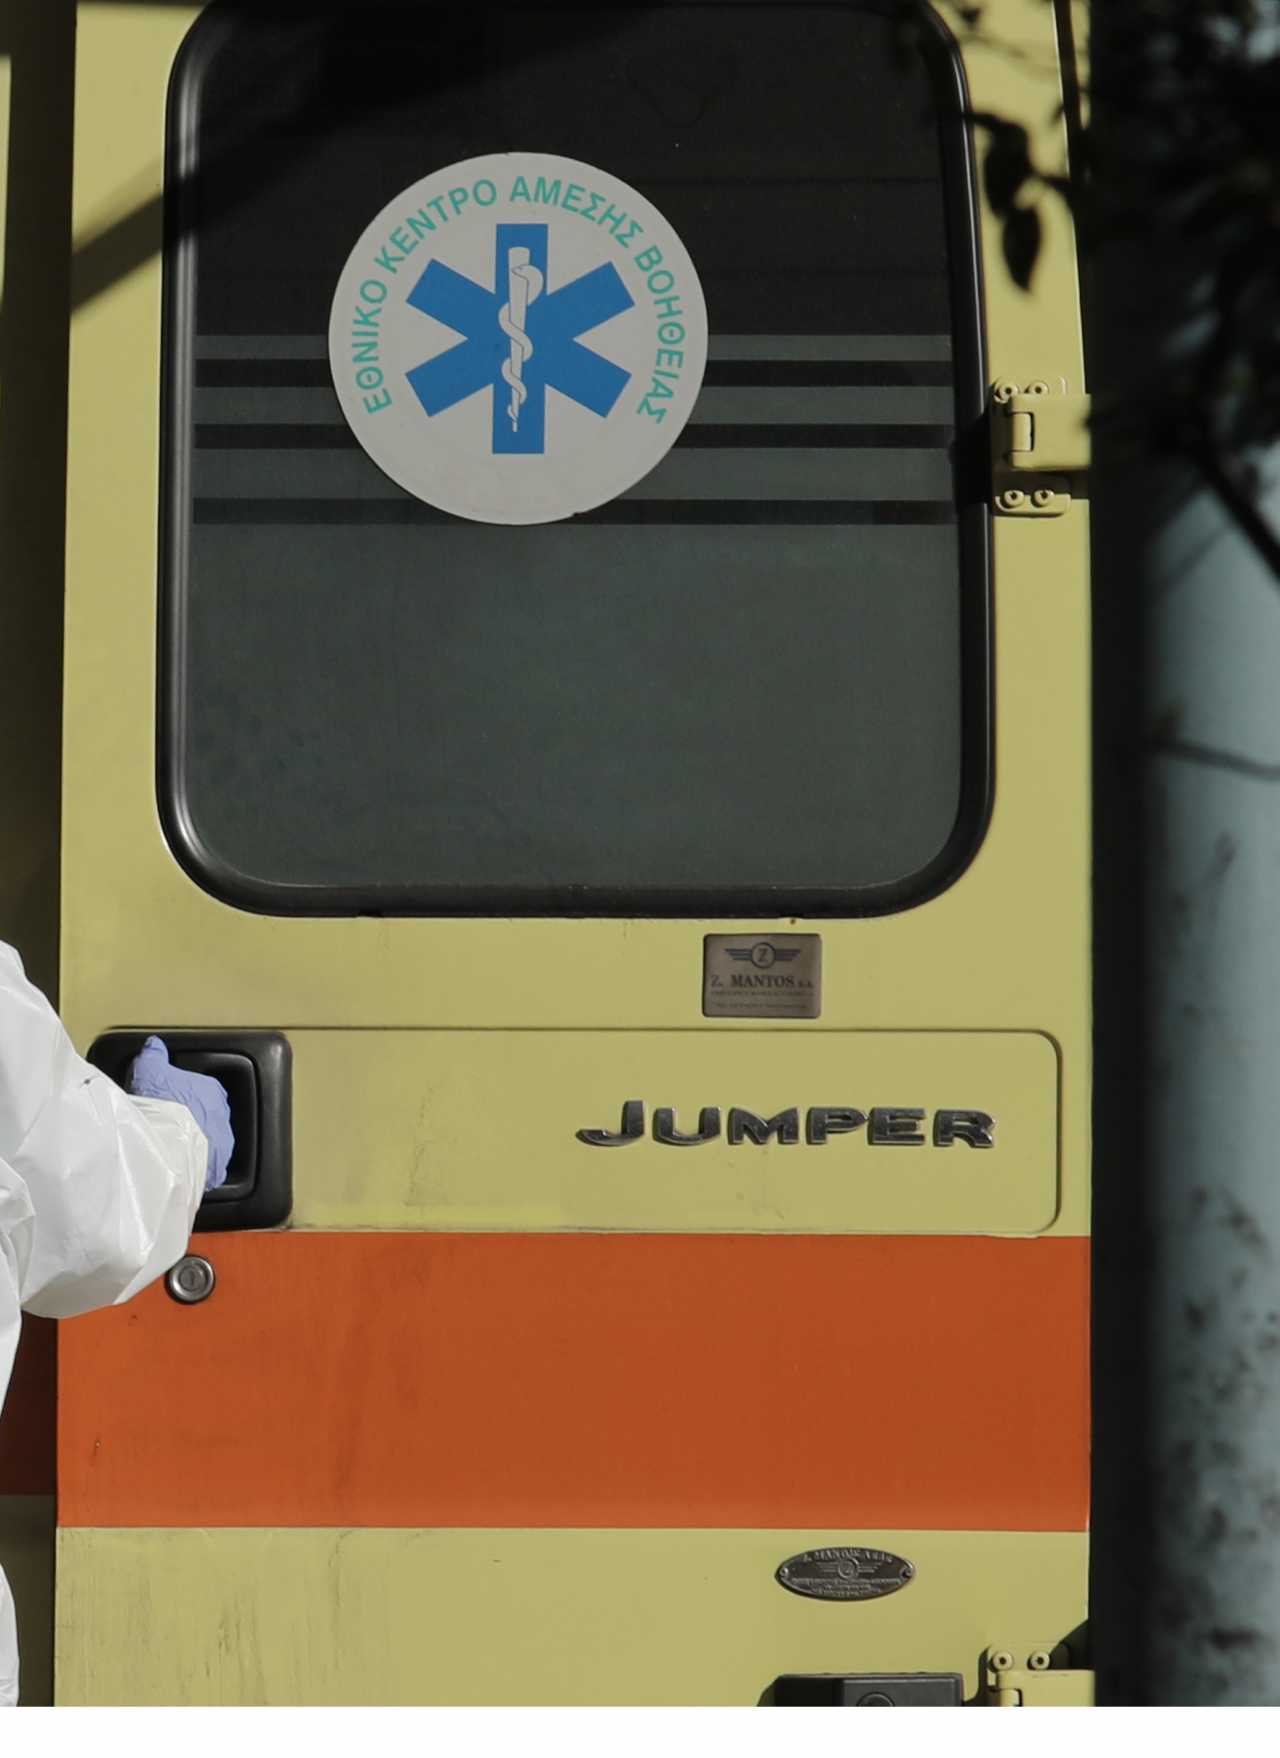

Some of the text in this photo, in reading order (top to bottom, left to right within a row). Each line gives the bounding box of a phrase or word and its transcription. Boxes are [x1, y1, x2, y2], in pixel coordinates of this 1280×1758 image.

[352, 175, 686, 424] ΕΘΝΙΚΟ ΚΕΝΤΡΟ ΑΜΕΣΗΣ ΒΟΗΘΕΙΑΣ
[730, 974, 795, 988] MANTOS
[575, 1100, 996, 1149] JUMPER
